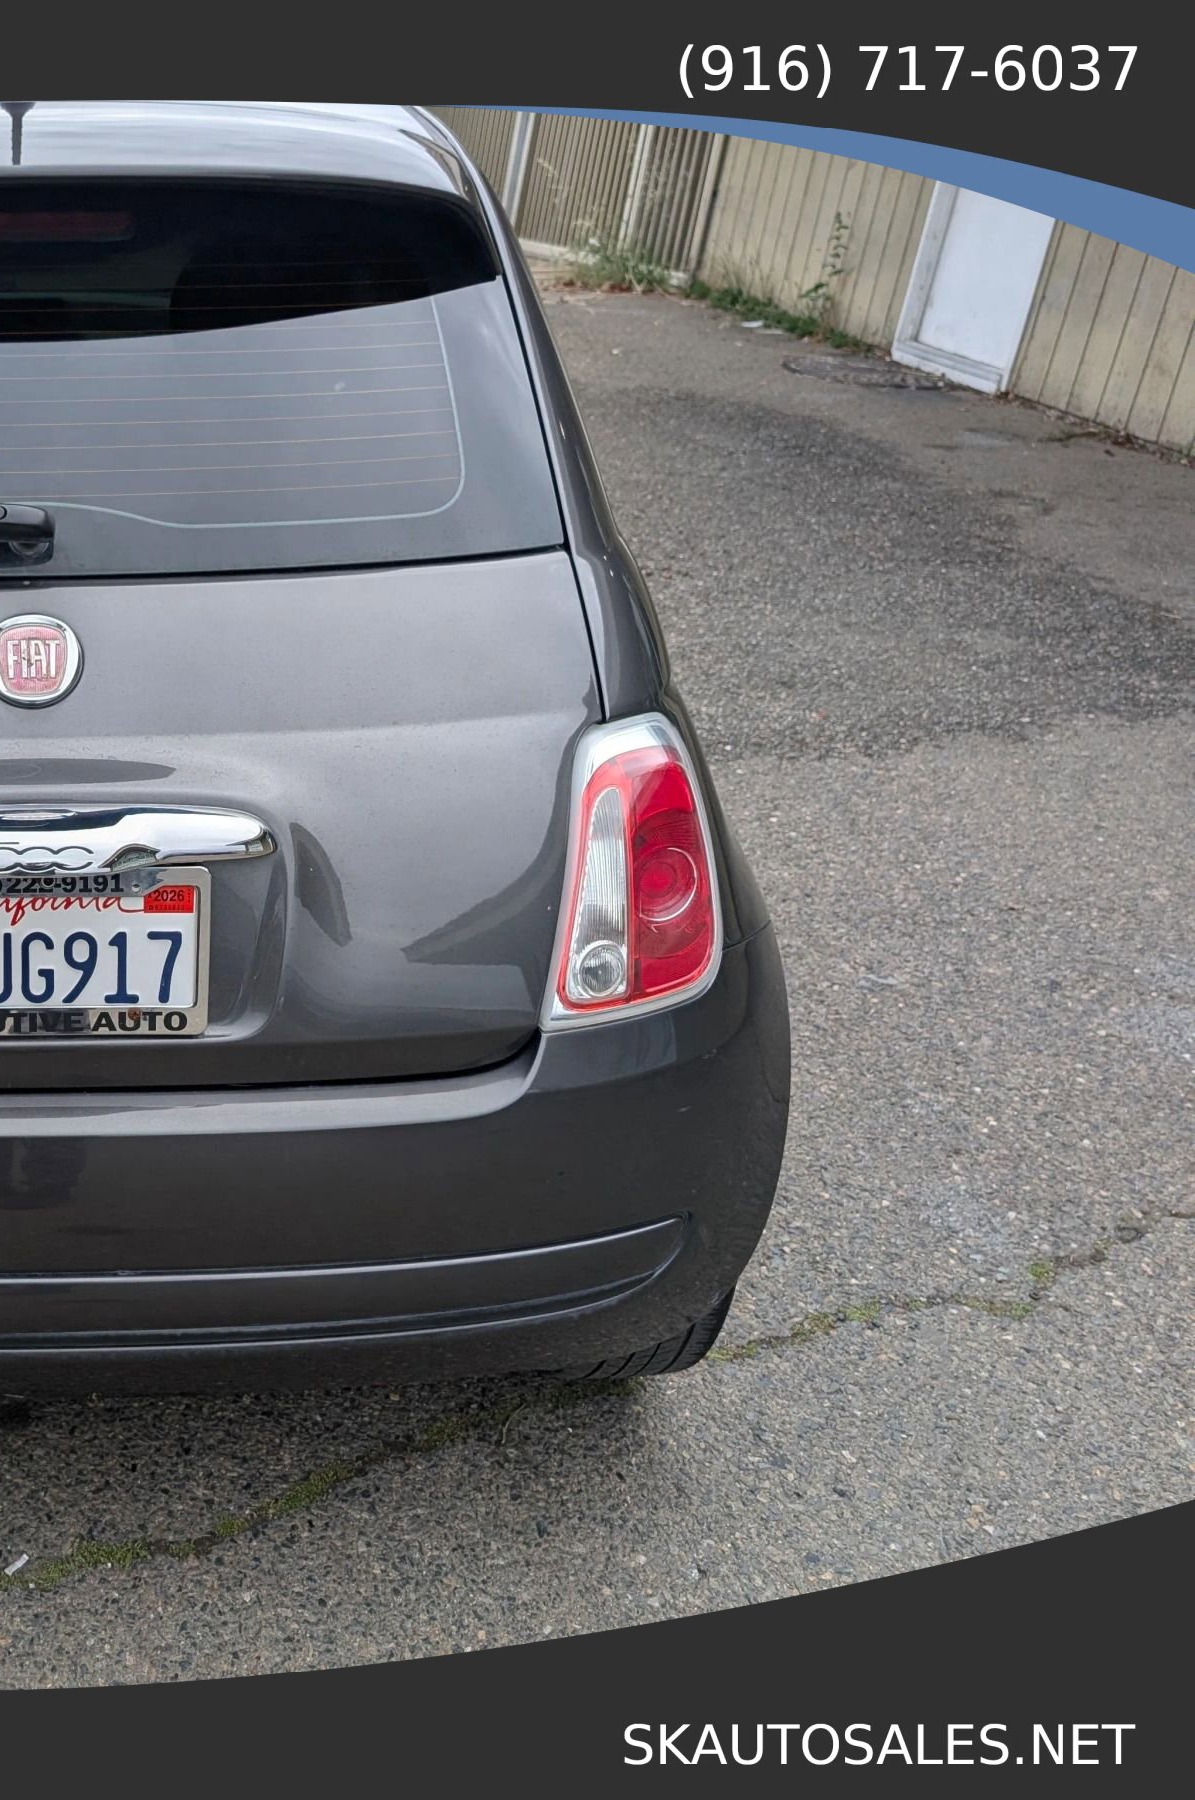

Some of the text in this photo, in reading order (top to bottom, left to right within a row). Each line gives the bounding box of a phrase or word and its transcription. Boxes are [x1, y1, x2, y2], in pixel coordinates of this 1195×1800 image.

[6, 638, 61, 680] FIAT
[154, 889, 185, 902] 2026
[91, 1011, 189, 1033] AUTO
